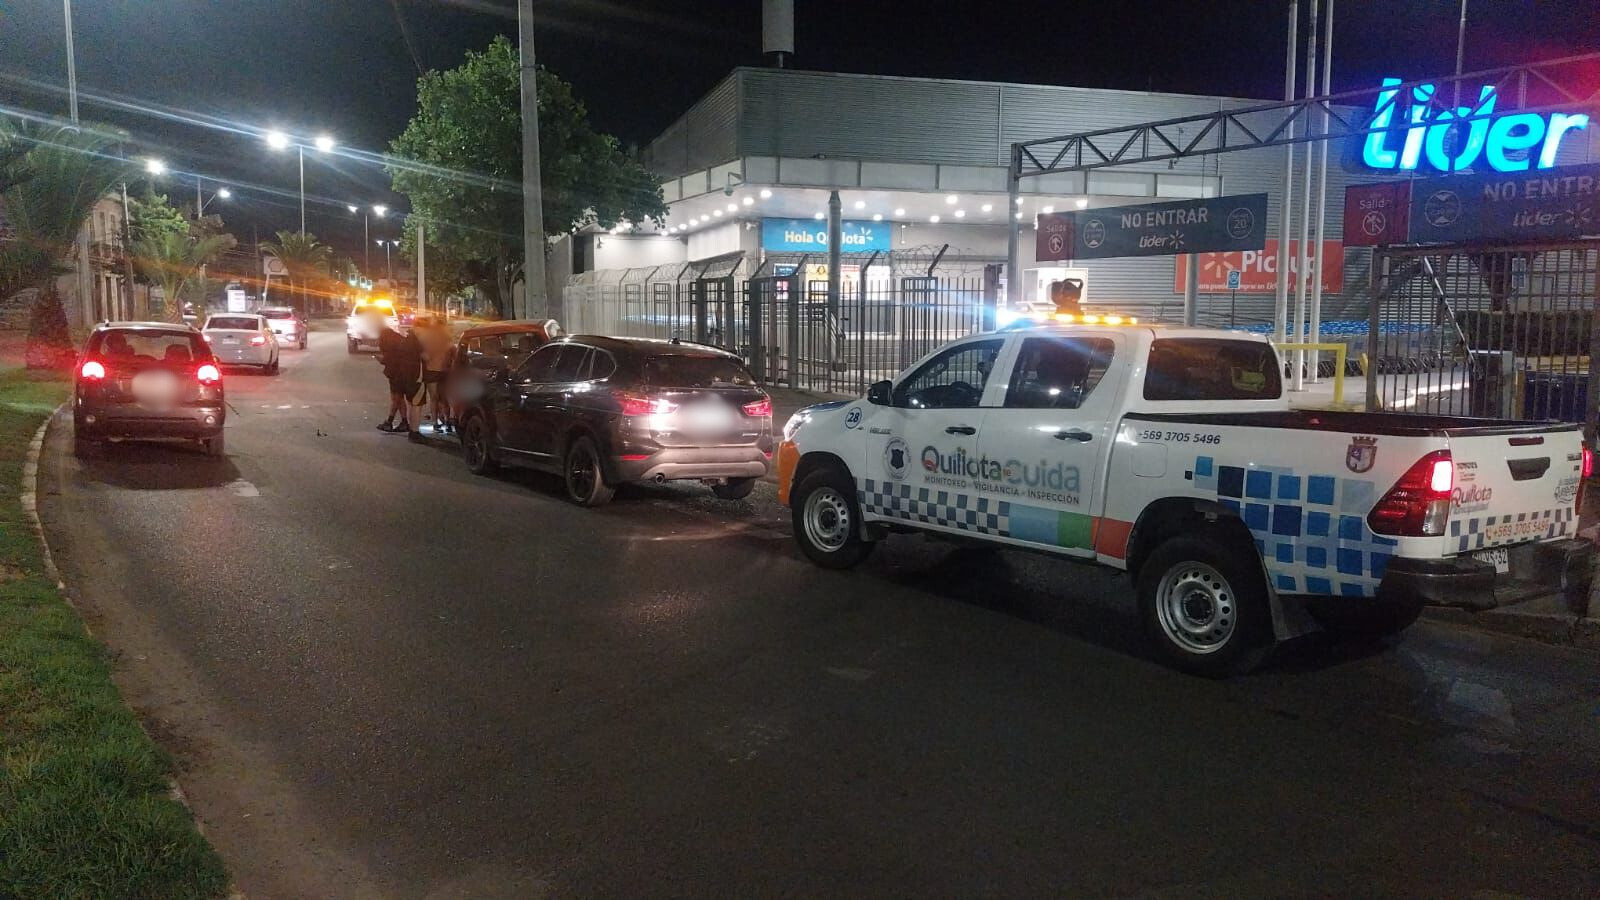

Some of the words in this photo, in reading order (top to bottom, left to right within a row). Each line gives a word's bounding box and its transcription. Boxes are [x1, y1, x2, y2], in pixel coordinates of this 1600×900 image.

[1363, 77, 1590, 172] Lider
[1484, 181, 1517, 201] NO
[1121, 213, 1141, 229] NO
[1146, 207, 1208, 227] ENTRAR
[784, 230, 814, 243] Hola
[816, 231, 866, 246] Qlota
[1241, 249, 1318, 280] Picup
[847, 412, 860, 423] 28
[1164, 432, 1190, 442] 3705
[1193, 434, 1221, 445] 5496
[921, 446, 1002, 481] Quillota
[1005, 459, 1080, 493] Cuida
[925, 475, 967, 488] MONITOREO
[974, 480, 1019, 497] VIGILANCIA
